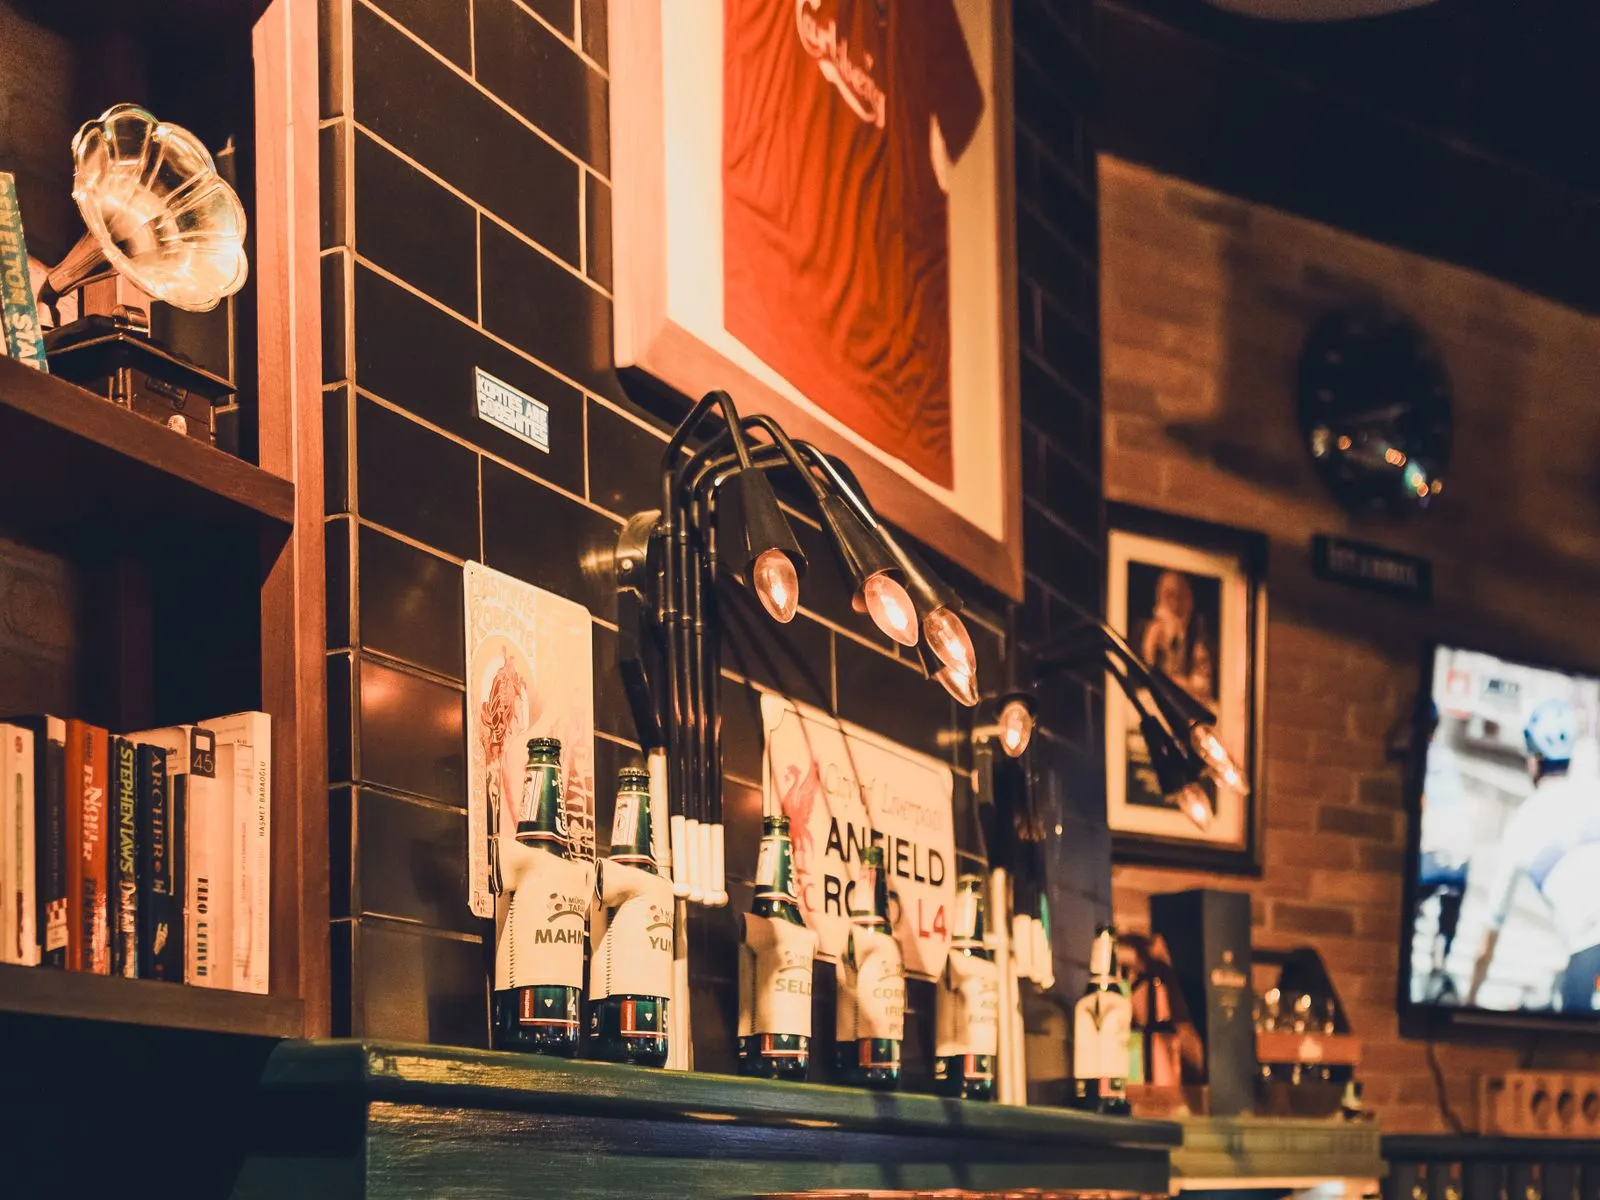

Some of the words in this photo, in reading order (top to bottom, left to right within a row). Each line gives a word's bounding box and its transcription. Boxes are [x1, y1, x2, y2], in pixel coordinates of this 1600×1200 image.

[120, 746, 134, 829] STEPHEN
[193, 754, 213, 773] 45
[151, 752, 164, 858] ARCHER
[119, 829, 136, 874] LAWS
[825, 817, 945, 886] ANFIELD
[824, 874, 903, 926] ROD
[918, 898, 947, 942] L4
